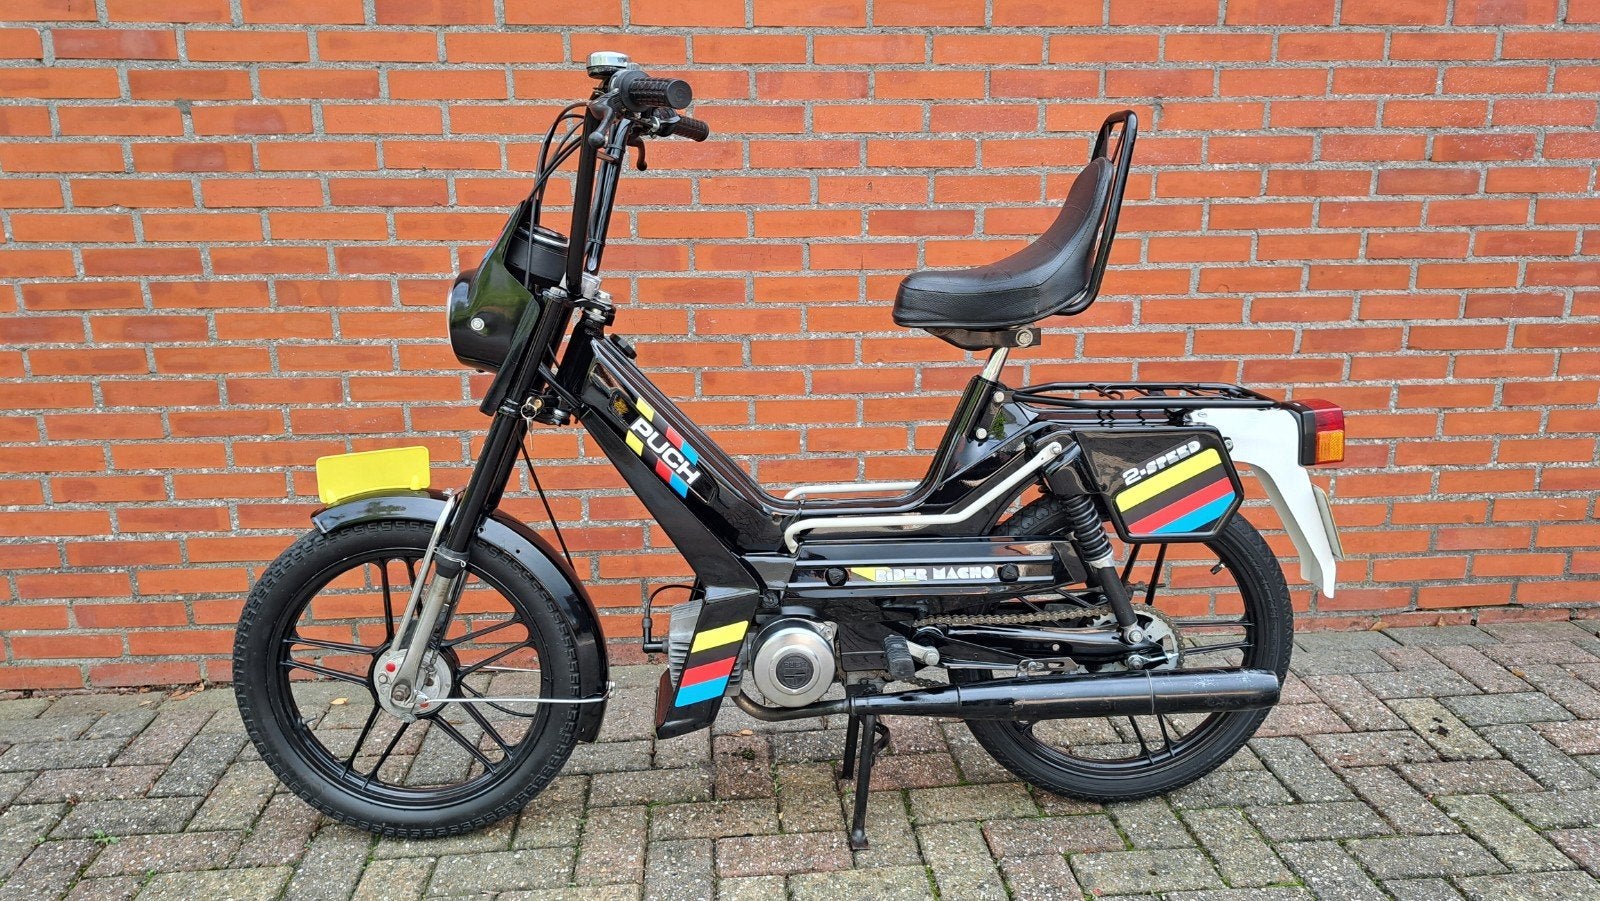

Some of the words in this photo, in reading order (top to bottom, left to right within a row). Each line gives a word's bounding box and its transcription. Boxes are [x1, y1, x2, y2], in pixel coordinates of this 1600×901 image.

[630, 417, 701, 485] PUCH
[1122, 440, 1201, 486] 2-SPEED
[875, 568, 928, 582] RIDER
[932, 565, 995, 580] MACHO
